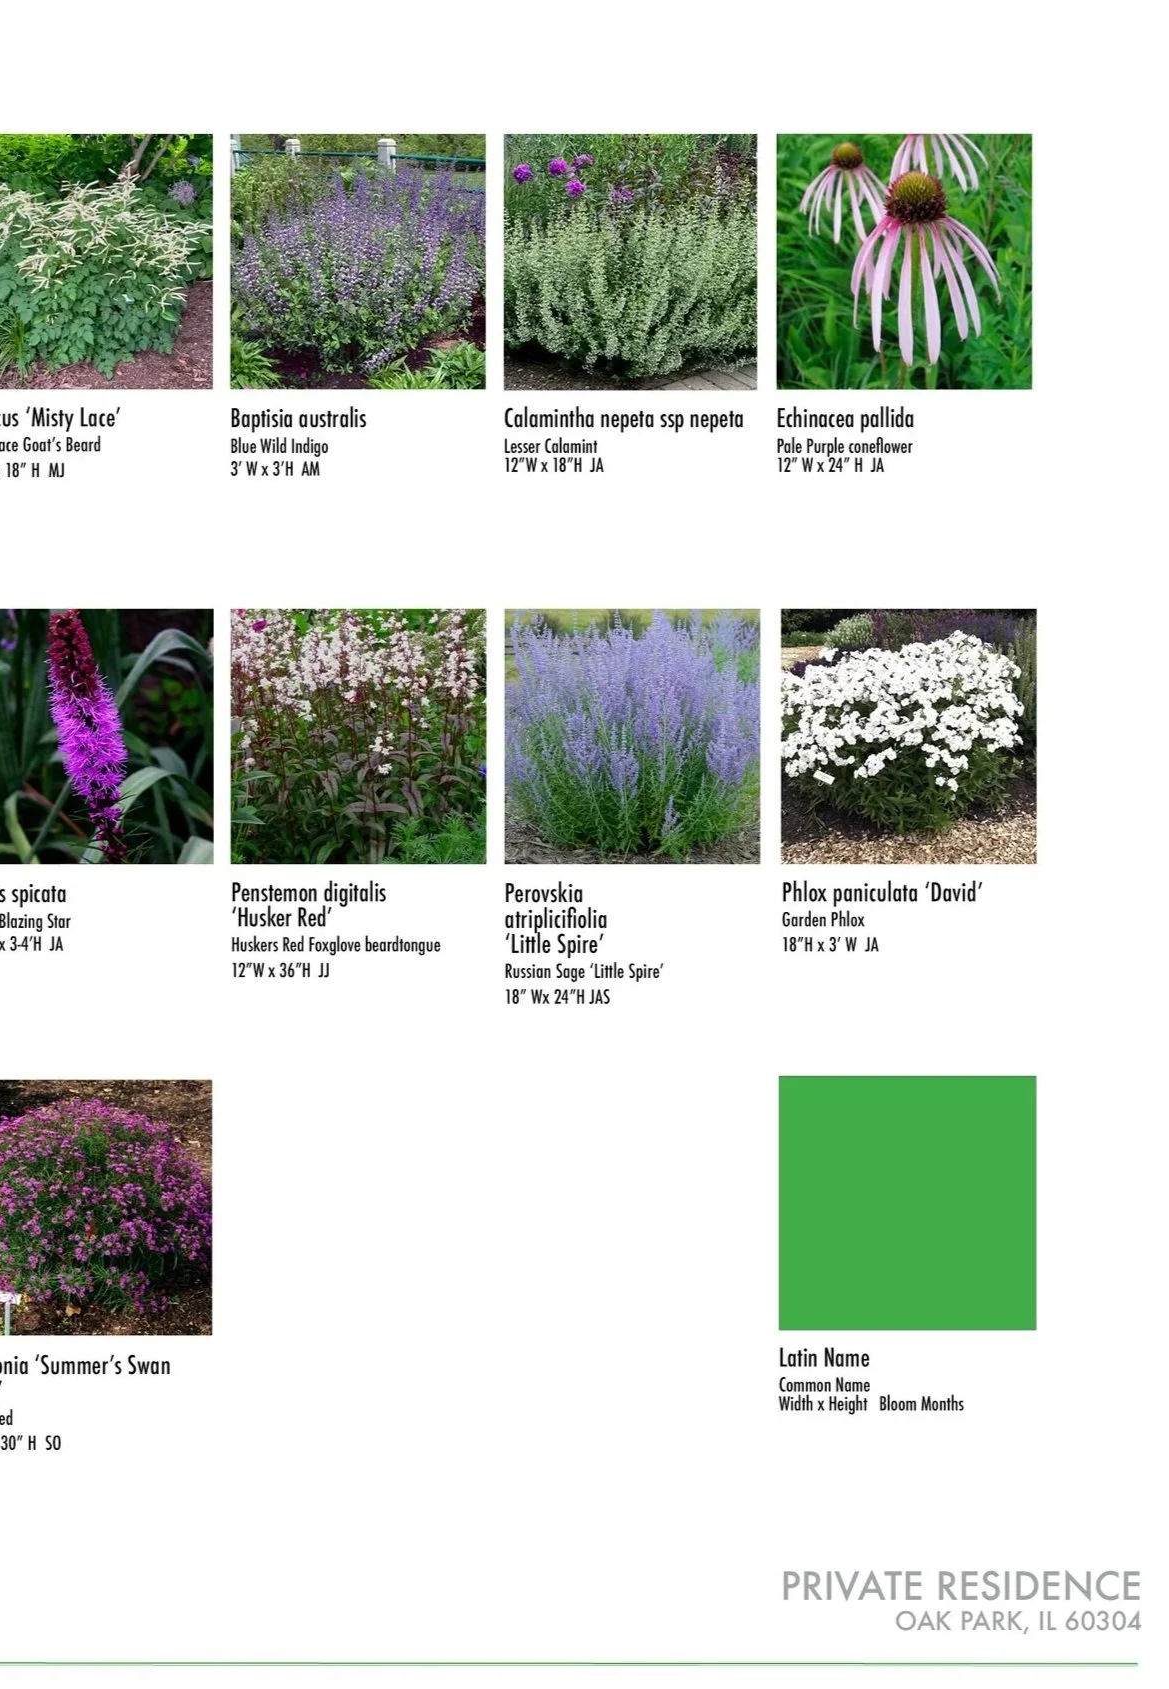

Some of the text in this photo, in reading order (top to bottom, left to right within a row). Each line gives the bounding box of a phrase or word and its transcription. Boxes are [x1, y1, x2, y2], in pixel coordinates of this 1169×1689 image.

[230, 405, 367, 434] Baptisia australis
[504, 405, 744, 434] Calamintha nepeta ssp nepeta
[777, 405, 915, 434] Echinacea pallida
[65, 434, 101, 453] Beard
[230, 436, 329, 458] Blue Wild Indigo
[504, 436, 598, 454] Lesser Calamint
[776, 435, 914, 458] Pale Purple coneflower
[540, 461, 549, 473] x
[589, 456, 605, 473] JA
[11, 883, 67, 909] spicata
[231, 879, 387, 908] Penstemon digitalis
[505, 880, 583, 904] Perovskia
[782, 879, 828, 903] Phlox
[832, 879, 918, 908] paniculata
[46, 912, 72, 929] Star
[503, 904, 609, 934] atriplicifiolia
[781, 909, 866, 928] Garden Phlox
[231, 934, 442, 957] Huskers Red Foxglove beardtongue
[504, 962, 552, 979] Russian
[555, 962, 586, 983] Sage
[127, 1354, 171, 1376] Swan
[779, 1346, 870, 1368] Latin Name
[778, 1376, 871, 1393] Common Name
[778, 1393, 965, 1416] Width x Height Bloom Months
[783, 1569, 1141, 1602] PRIVATE RESIDENCE
[895, 1610, 1142, 1635] OAK PARK, IL 60304
